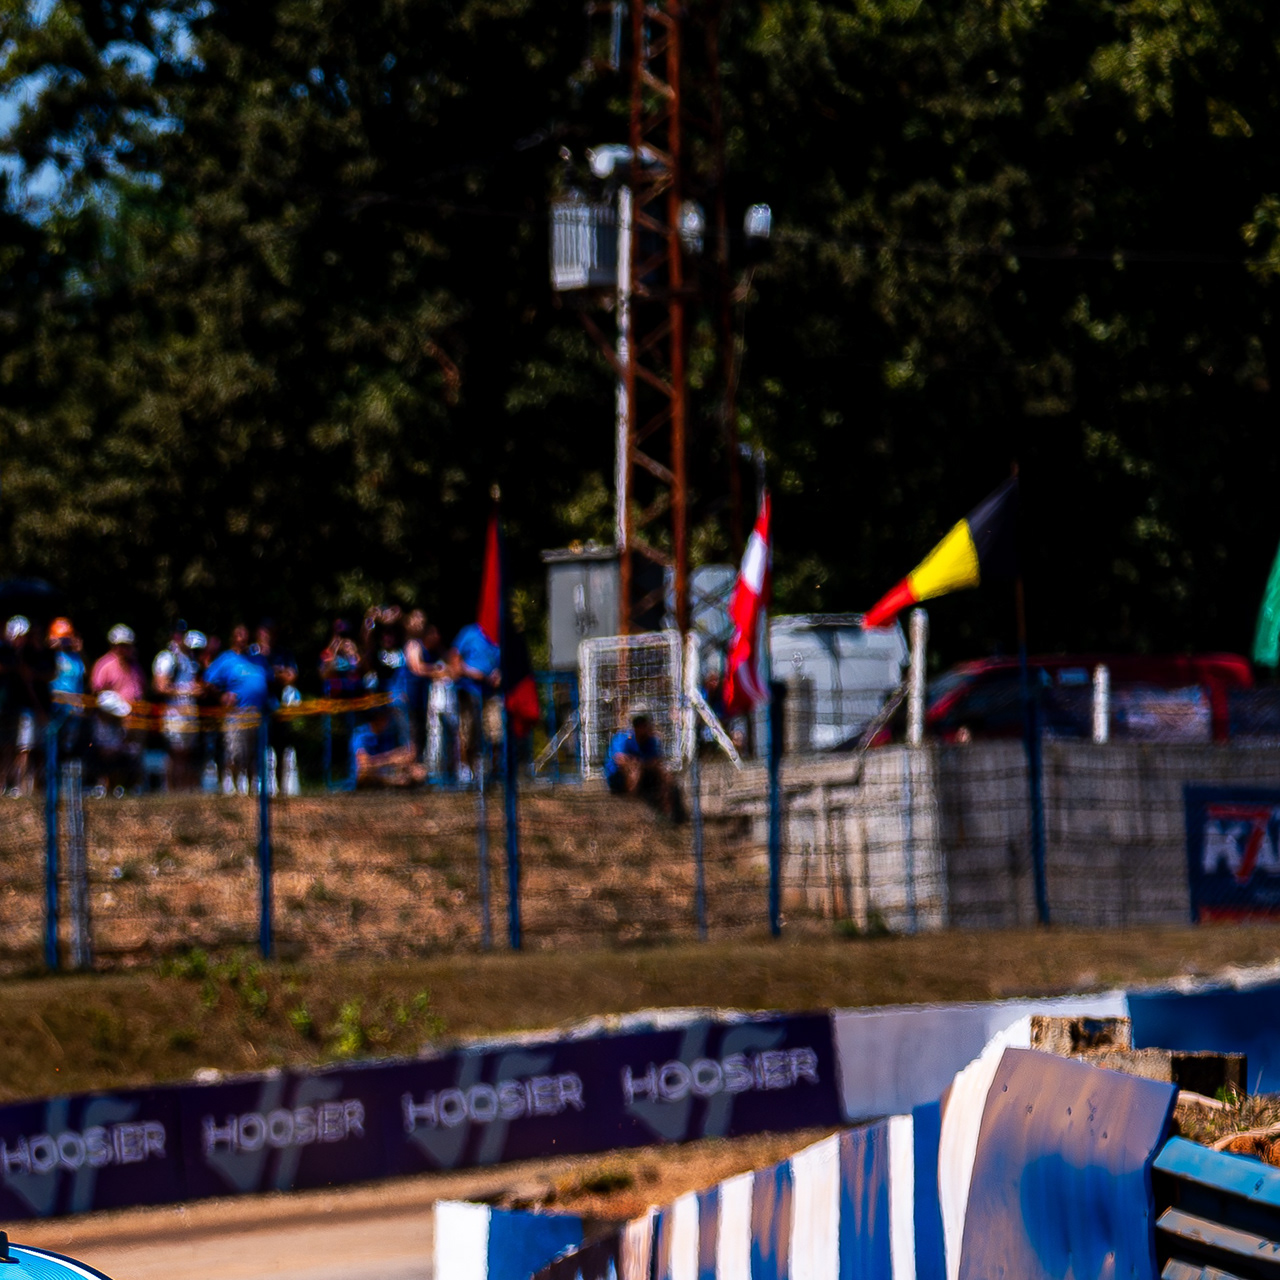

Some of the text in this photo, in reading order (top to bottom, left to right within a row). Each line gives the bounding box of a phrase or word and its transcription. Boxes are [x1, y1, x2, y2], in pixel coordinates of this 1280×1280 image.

[402, 1073, 585, 1132] HOOSIER
[621, 1047, 819, 1104] HOOSIER
[202, 1100, 365, 1155] HOOSIER
